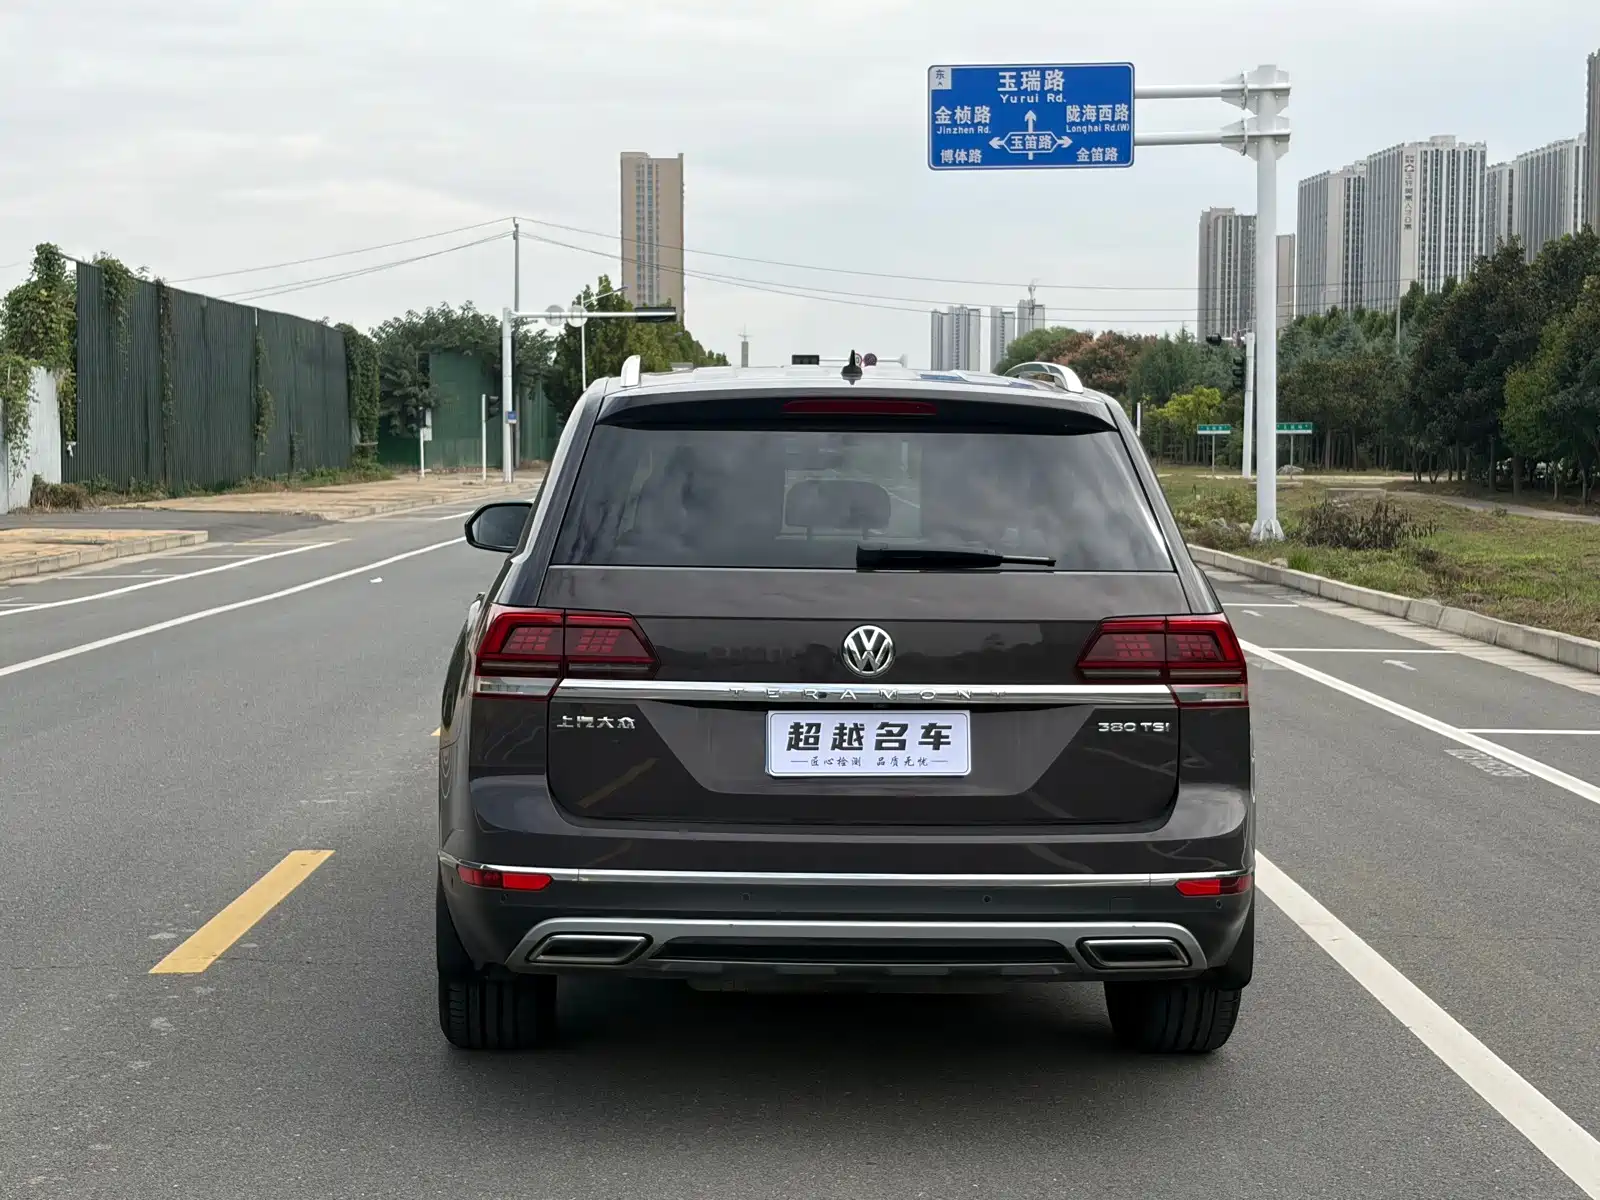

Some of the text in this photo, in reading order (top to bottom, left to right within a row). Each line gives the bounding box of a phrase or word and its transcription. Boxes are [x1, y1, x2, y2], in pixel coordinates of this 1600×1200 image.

[935, 69, 945, 80] 东
[997, 69, 1065, 92] 玉瑞路
[1000, 93, 1067, 104] Yurui Rd.
[934, 105, 992, 125] 金桢路
[1066, 103, 1130, 123] 陇海西路
[936, 125, 992, 135] Jinzhen Rd.
[1066, 124, 1102, 135] Longhai
[1010, 134, 1052, 150] 玉笛路
[940, 149, 983, 164] 博体路
[1076, 147, 1119, 162] 金笛路
[729, 687, 1006, 701] TERAMONT
[1098, 722, 1137, 732] 380
[786, 721, 953, 751] 超越名车
[810, 756, 929, 767] 匠心检测 品质无忧
